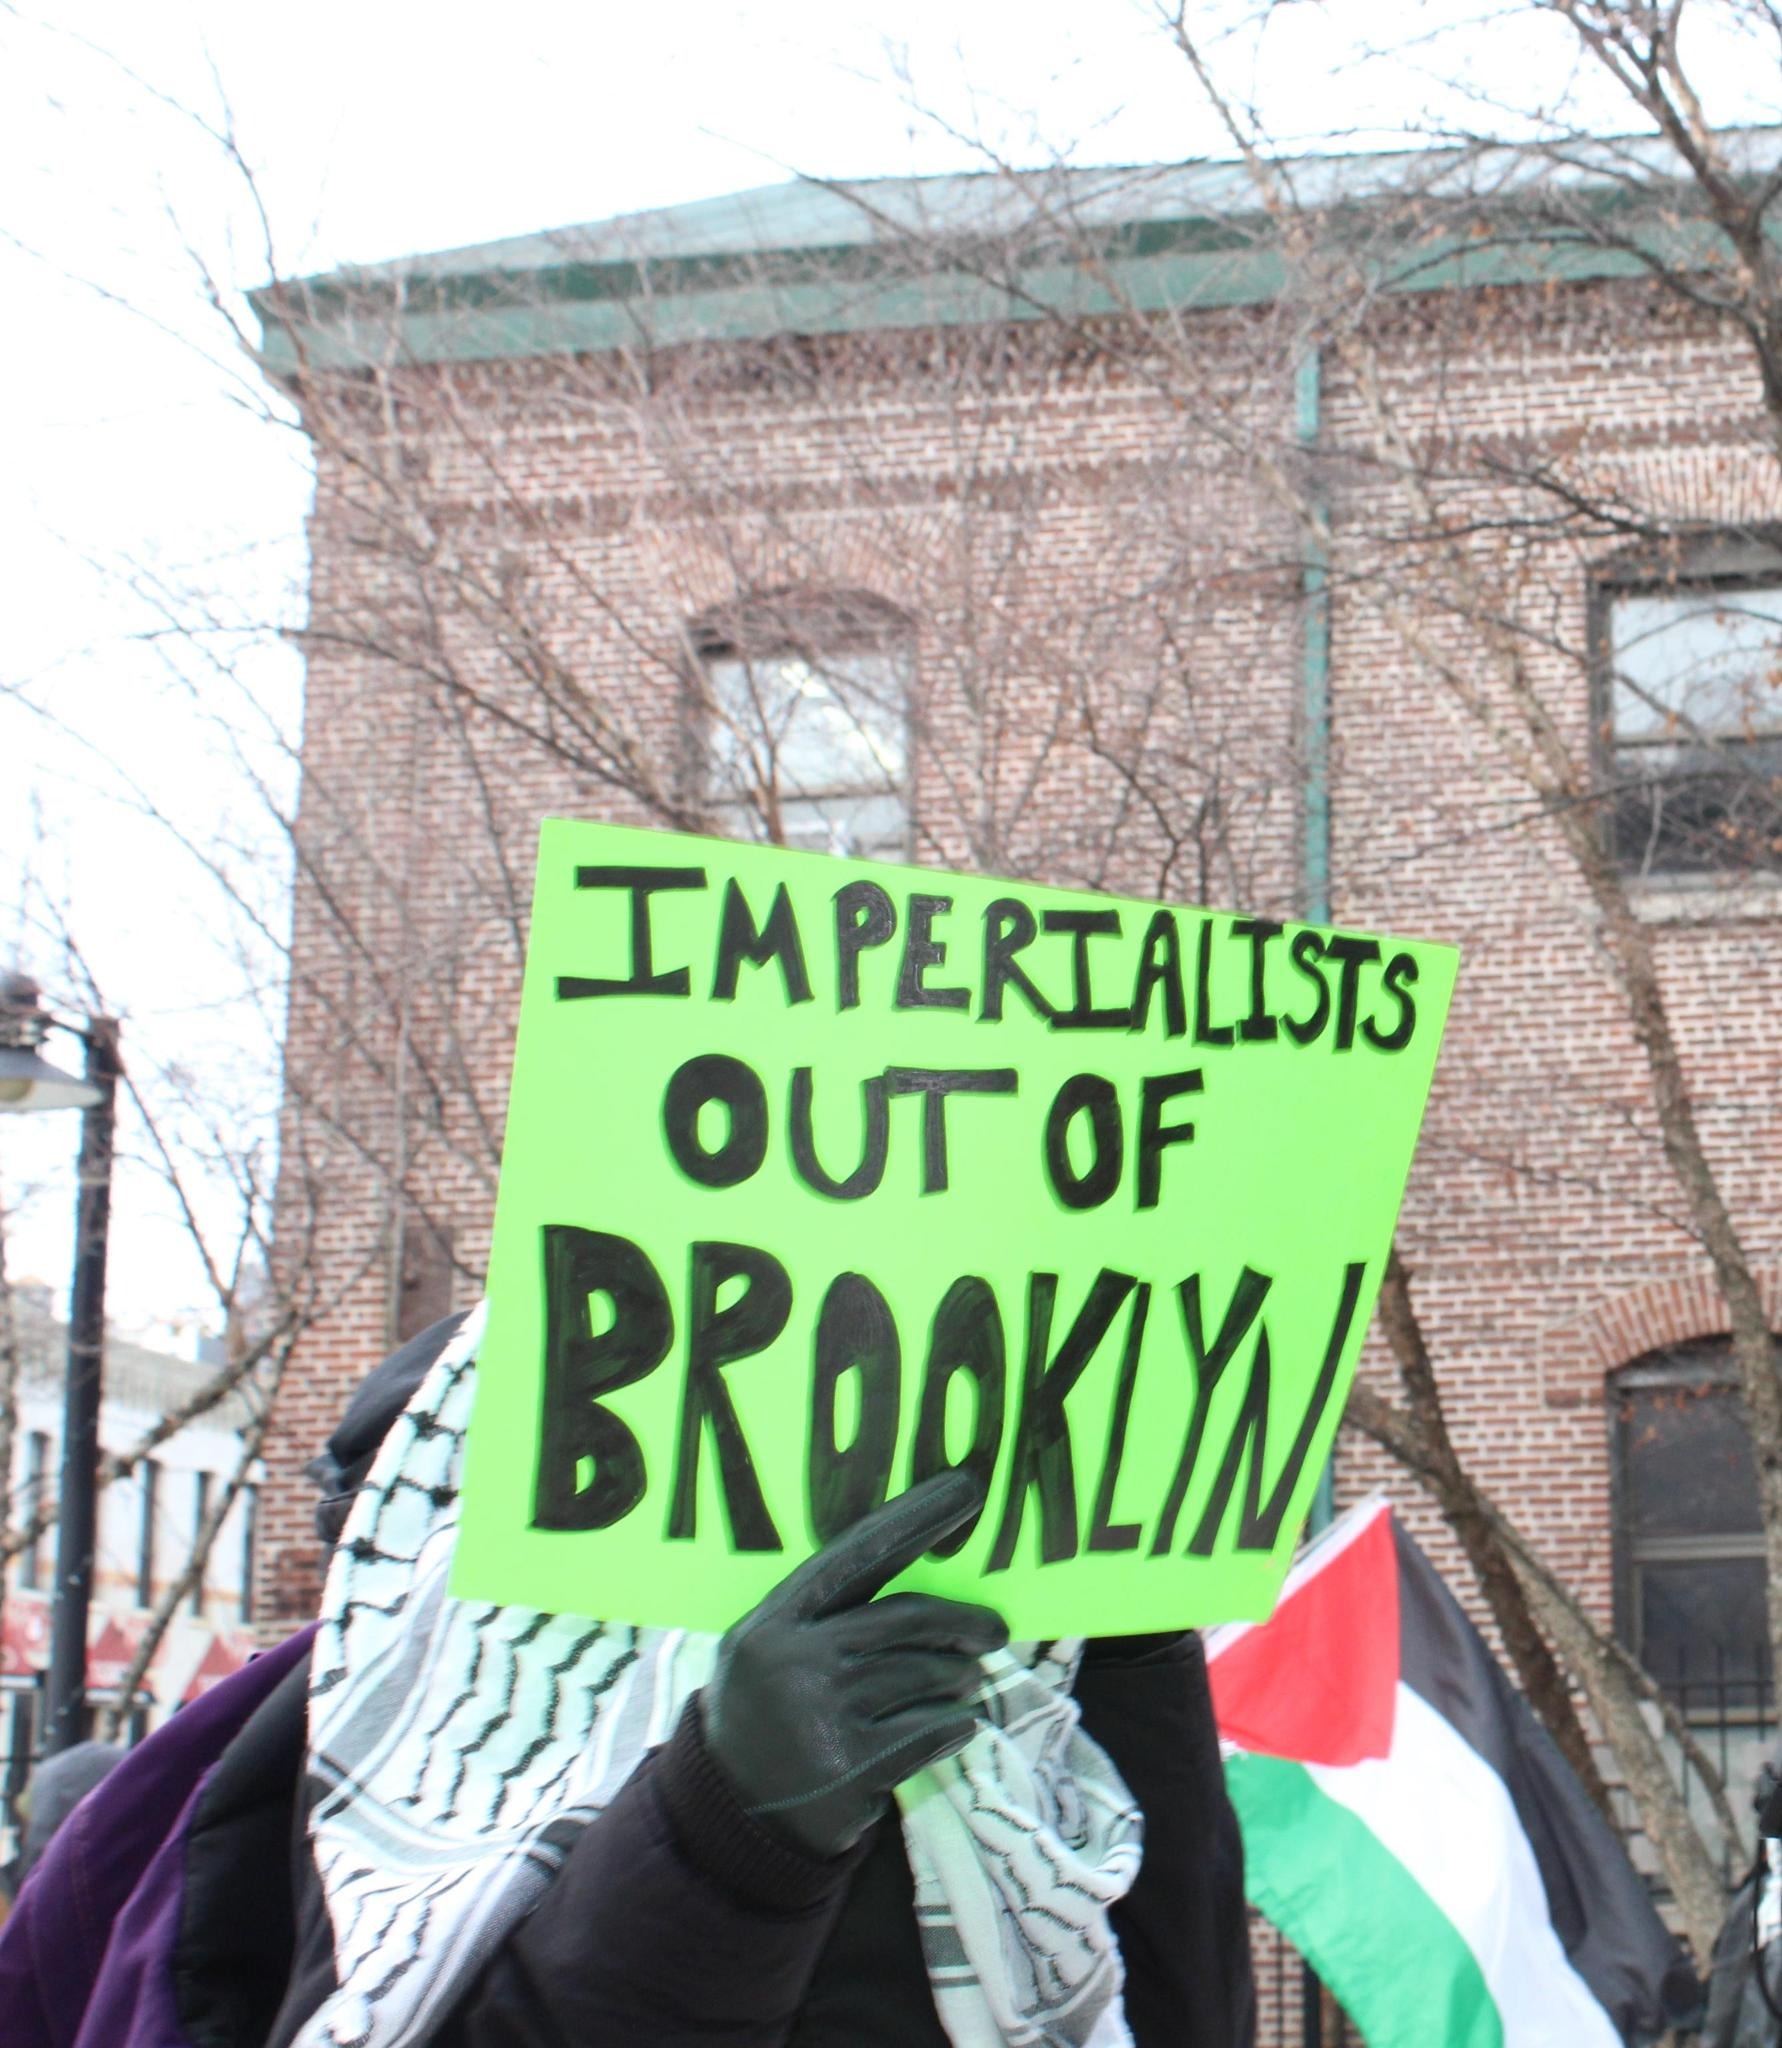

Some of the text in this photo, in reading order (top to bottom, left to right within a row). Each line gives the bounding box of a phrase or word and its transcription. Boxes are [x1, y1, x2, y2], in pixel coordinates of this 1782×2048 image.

[556, 865, 1419, 1052] IMPERIALISTS
[663, 1053, 1205, 1211] OUT OF
[528, 1224, 1368, 1576] BROOKLYN
